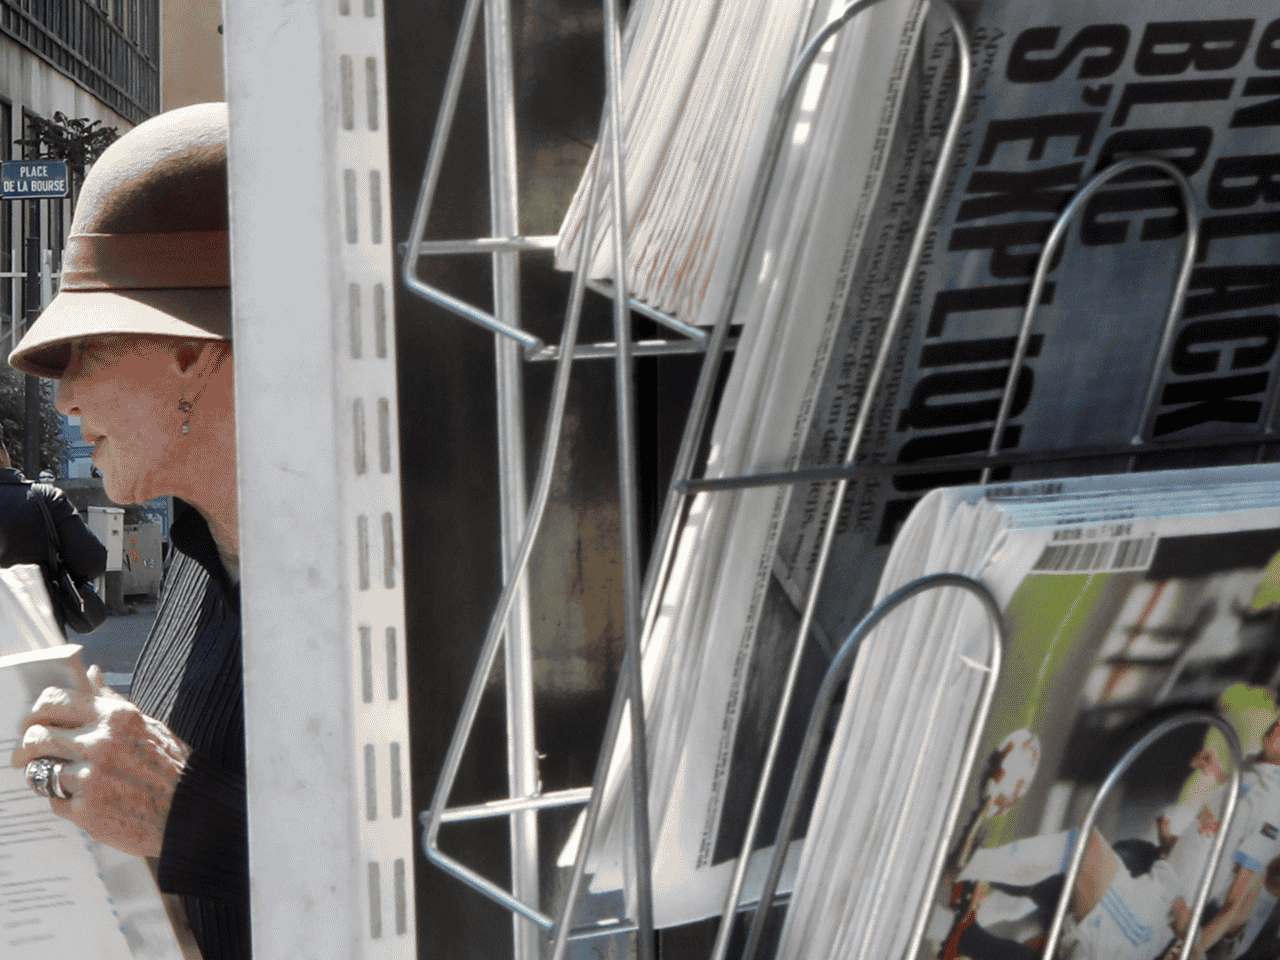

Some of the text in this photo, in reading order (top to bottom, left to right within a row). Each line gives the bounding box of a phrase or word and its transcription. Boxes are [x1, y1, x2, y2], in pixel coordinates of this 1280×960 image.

[1078, 17, 1257, 248] BLOC
[20, 166, 48, 178] PLACE
[3, 181, 65, 192] DE LA BOURSE
